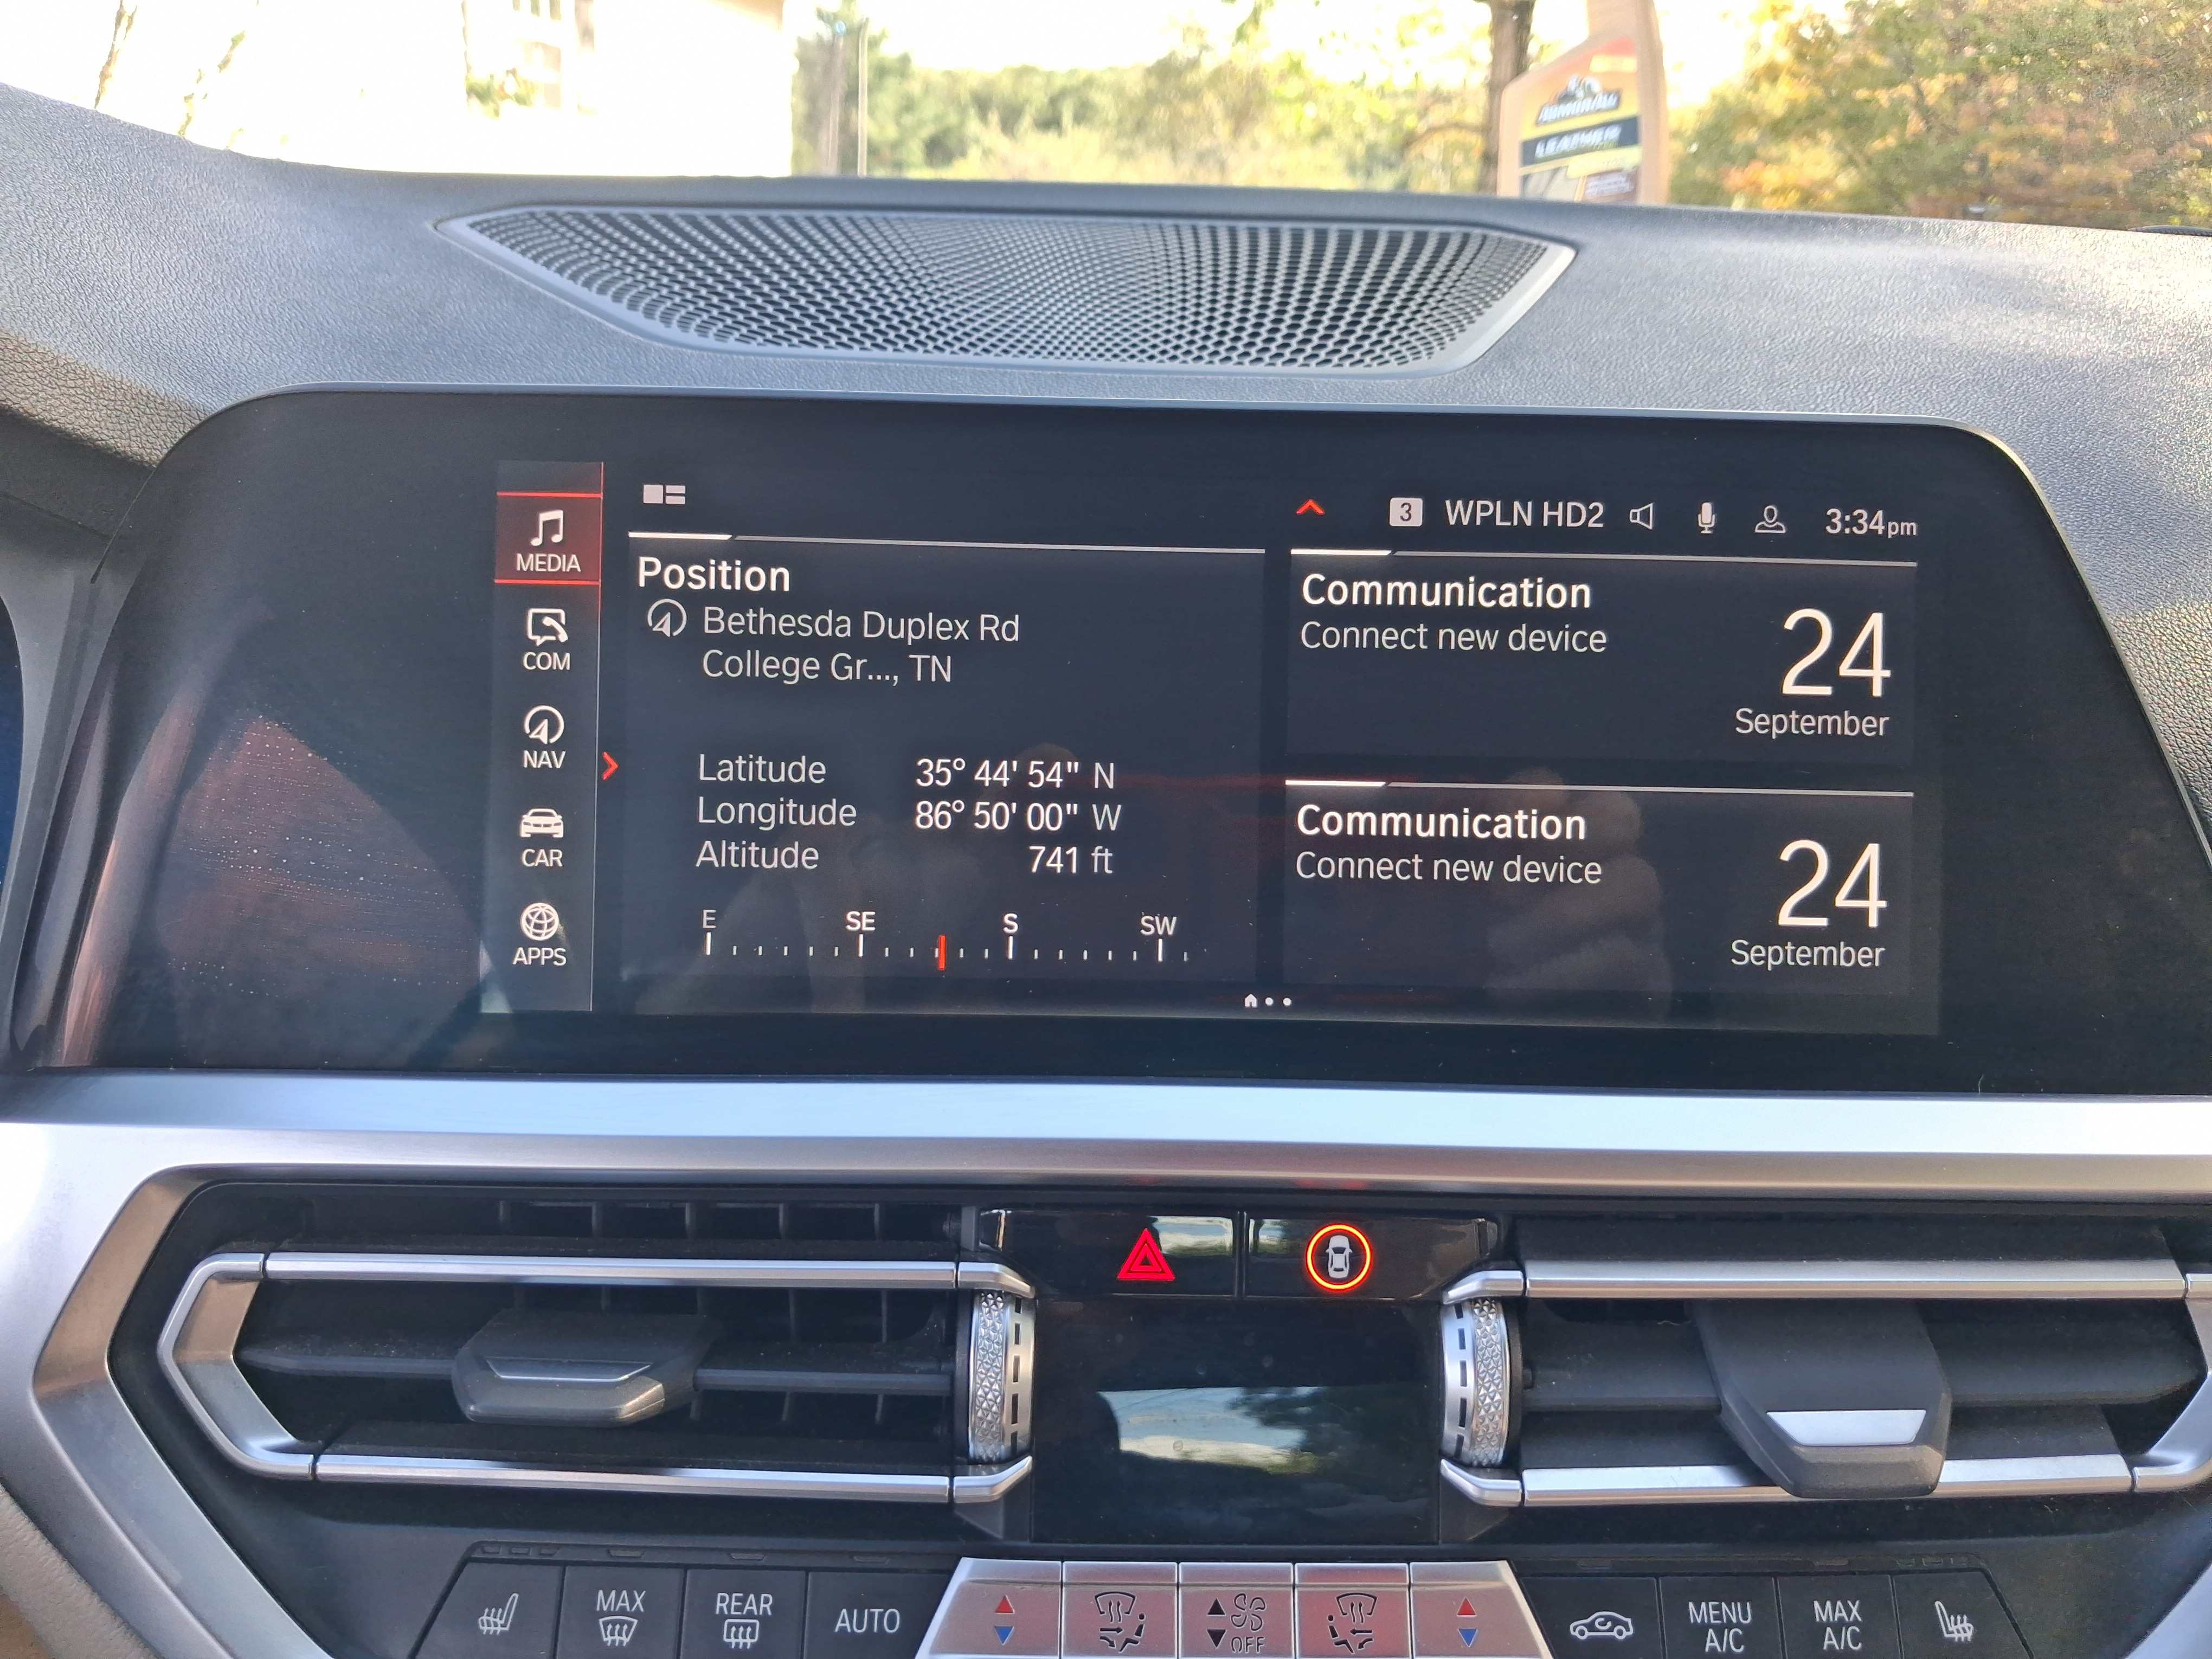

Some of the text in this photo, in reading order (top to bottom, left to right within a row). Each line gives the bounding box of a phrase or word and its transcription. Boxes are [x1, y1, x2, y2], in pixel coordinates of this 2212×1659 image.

[1400, 502, 1412, 522] 3
[1445, 500, 1604, 528] WPLN HD2
[1825, 508, 1917, 539] 3:34pm
[516, 553, 581, 573] MEDIA
[639, 556, 789, 591] Position
[1302, 573, 1591, 608] Communication
[704, 606, 1019, 646] Bethesda Duplex Rd
[1301, 621, 1607, 652] Connect new device
[523, 652, 570, 671] COM
[1782, 608, 1892, 697] 24
[703, 650, 820, 685] College
[908, 654, 951, 683] TN
[1735, 708, 1890, 740] September
[523, 750, 566, 769] NAV
[699, 754, 826, 783] Latitude
[916, 758, 966, 787] 35°
[1095, 762, 1114, 789] N
[698, 796, 857, 831] Longitude
[915, 800, 965, 829] 86°
[1091, 803, 1122, 831] W
[1297, 804, 1586, 840] Communication
[522, 848, 563, 867] CAR
[696, 840, 1113, 874] Altitude 741 ft
[1296, 851, 1602, 884] Connect new device
[1778, 840, 1887, 928] 24
[703, 909, 1177, 936] E SE S SW
[512, 947, 567, 966] APPS
[1731, 939, 1886, 971] September
[596, 1589, 646, 1612] MAX
[716, 1592, 773, 1616] REAR
[1688, 1602, 1752, 1624] MENU
[1814, 1600, 1862, 1622] MAX
[834, 1608, 900, 1633] AUTO
[1231, 1636, 1265, 1652] OFF
[1705, 1628, 1745, 1652] A/C
[1823, 1626, 1862, 1650] A/C
